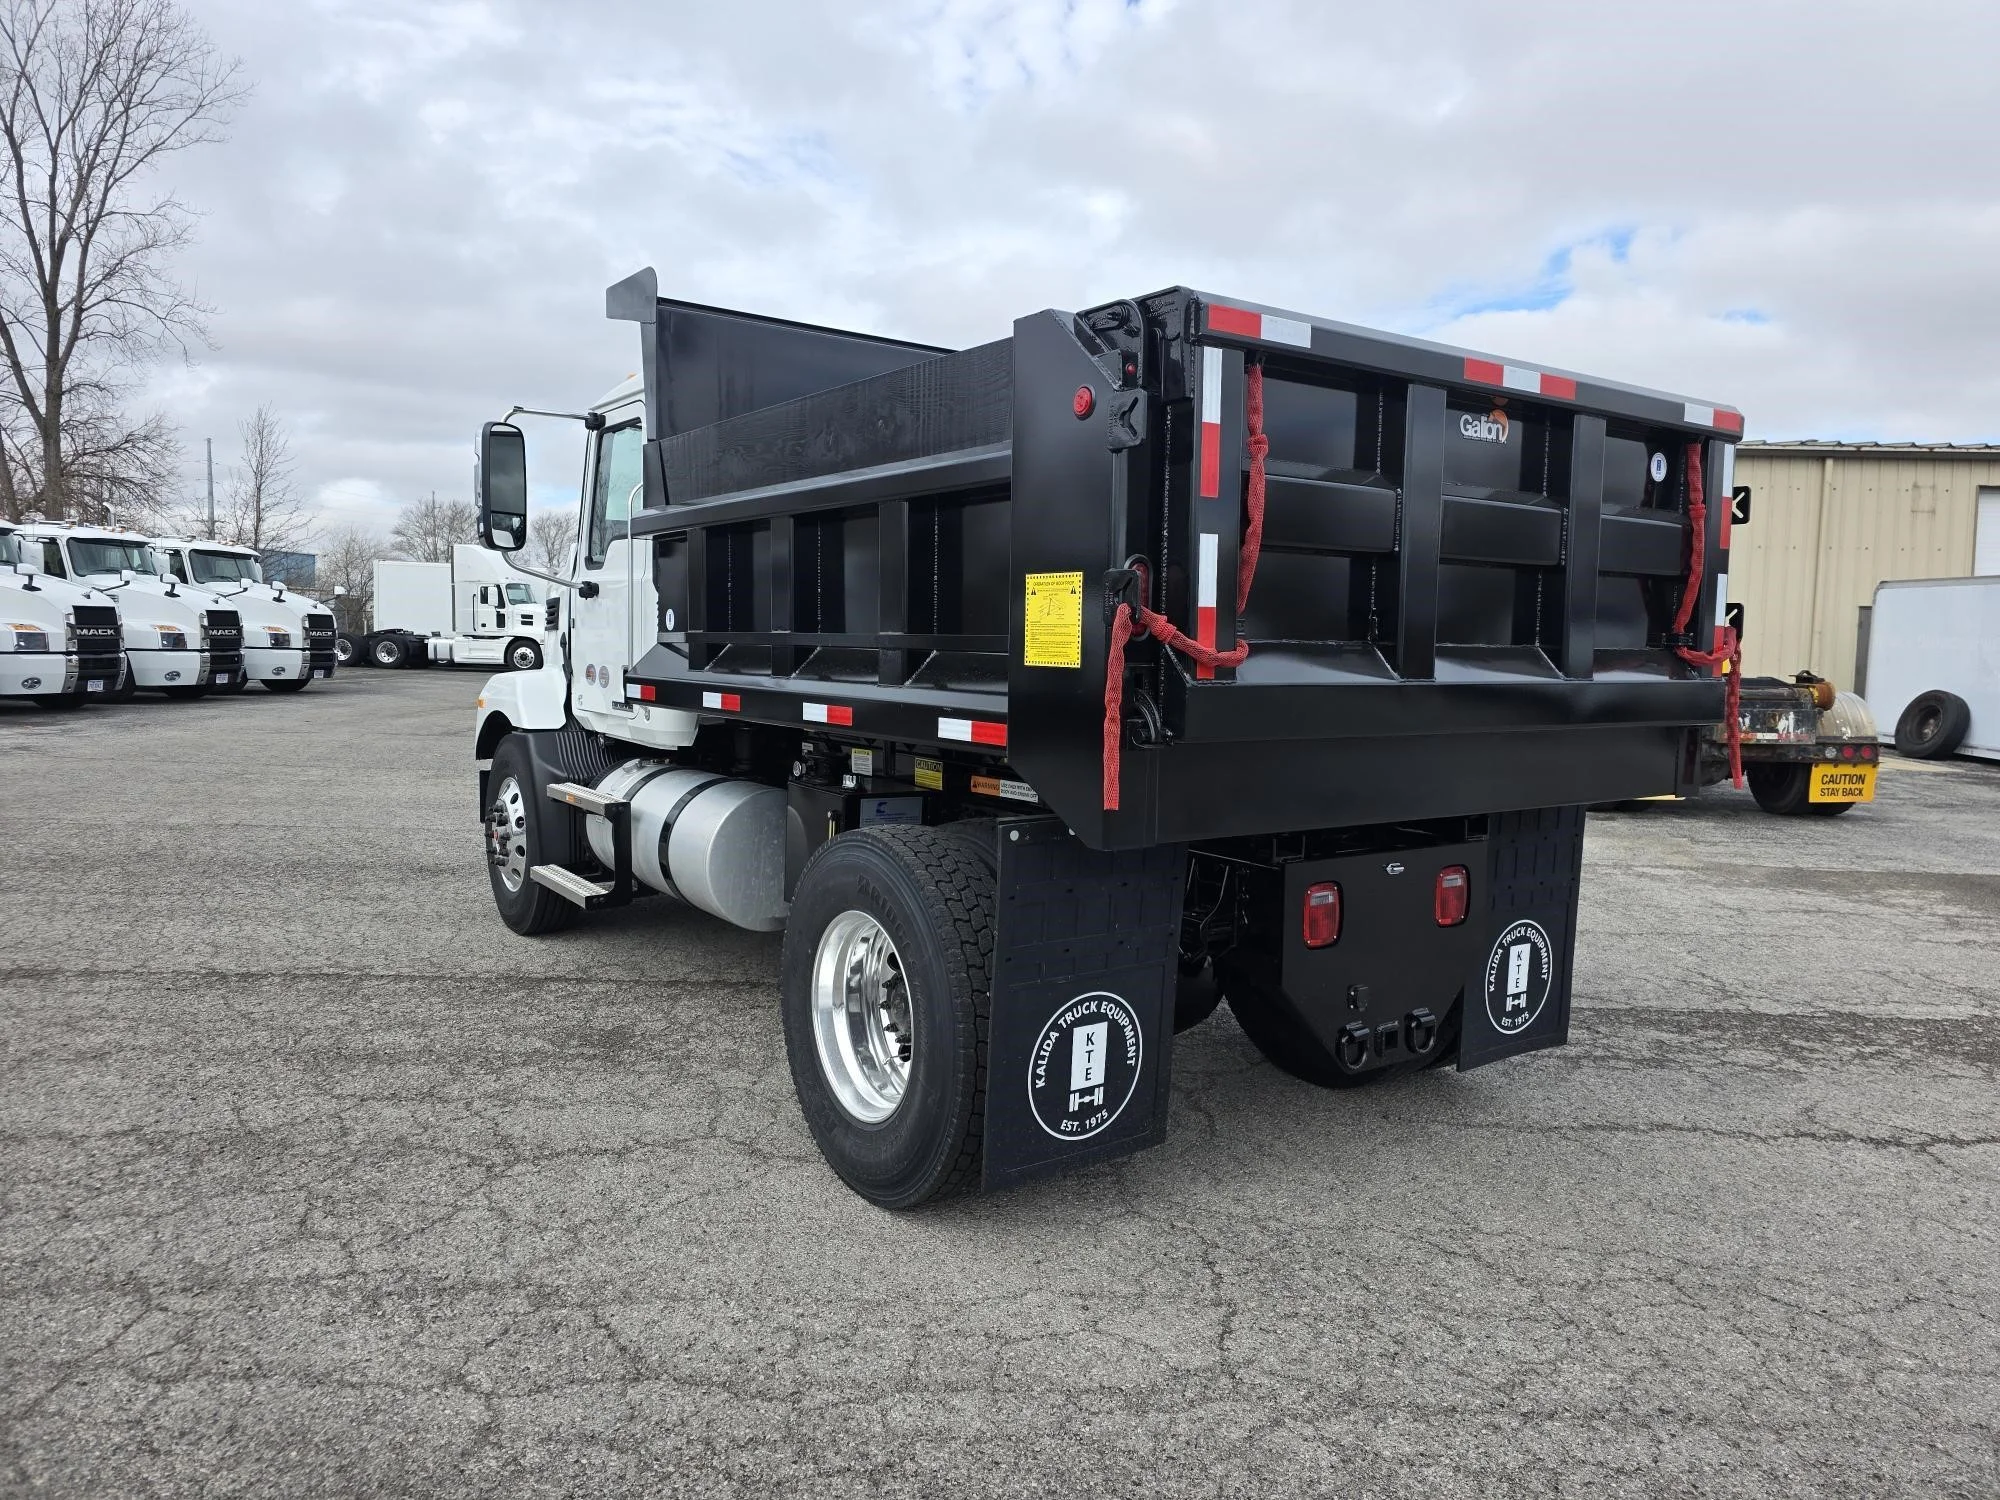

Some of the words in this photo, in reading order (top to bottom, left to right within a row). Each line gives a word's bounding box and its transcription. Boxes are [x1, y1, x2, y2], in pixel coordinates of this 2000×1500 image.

[1459, 414, 1503, 441] Galion
[76, 628, 116, 636] MACK
[208, 628, 239, 636] MACK
[916, 759, 944, 772] CAUTION
[1821, 773, 1866, 785] CAUTION
[1819, 787, 1841, 797] STAY
[1841, 786, 1864, 797] BACK
[1488, 948, 1504, 993] KALIDA
[1501, 926, 1526, 947] TRUCK
[1526, 927, 1549, 981] EQUIPMENT
[1501, 1016, 1513, 1028] EST.
[1514, 1011, 1530, 1027] 1975
[1035, 1030, 1060, 1089] KALIDA
[1057, 1000, 1099, 1029] TRUCK
[1099, 1000, 1138, 1067] EQUIPMENT
[1060, 1119, 1081, 1132] EST.
[1085, 1108, 1109, 1130] 1975
